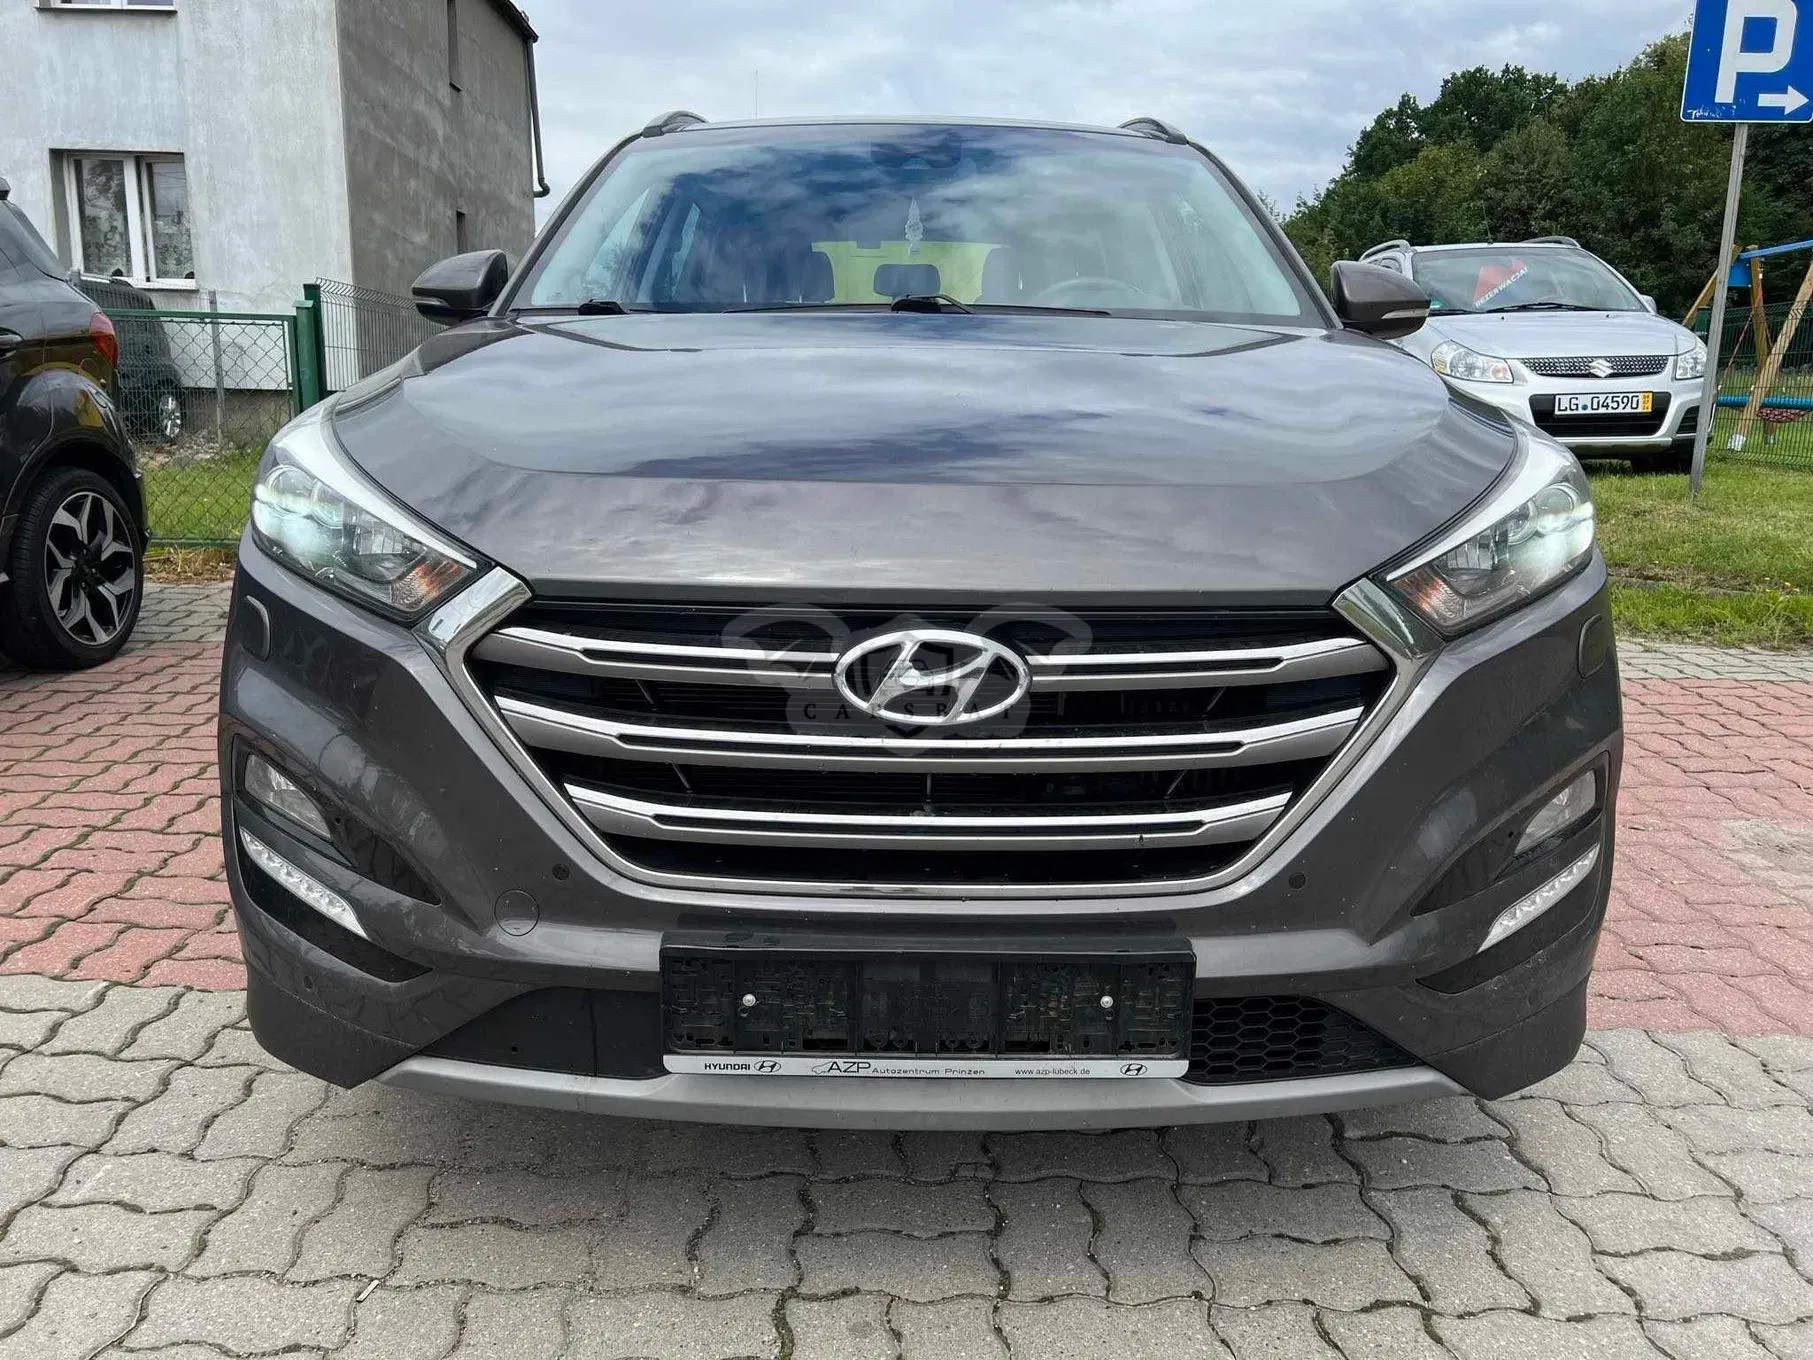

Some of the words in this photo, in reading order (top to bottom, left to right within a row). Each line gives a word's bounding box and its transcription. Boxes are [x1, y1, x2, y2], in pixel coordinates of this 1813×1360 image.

[1714, 0, 1797, 103] P
[1557, 397, 1579, 412] LG
[1591, 395, 1639, 410] 04590
[704, 1062, 751, 1071] HYUNDAI
[827, 1061, 871, 1073] AZP
[872, 1067, 940, 1075] Autozentrum
[945, 1068, 985, 1076] Prinzen
